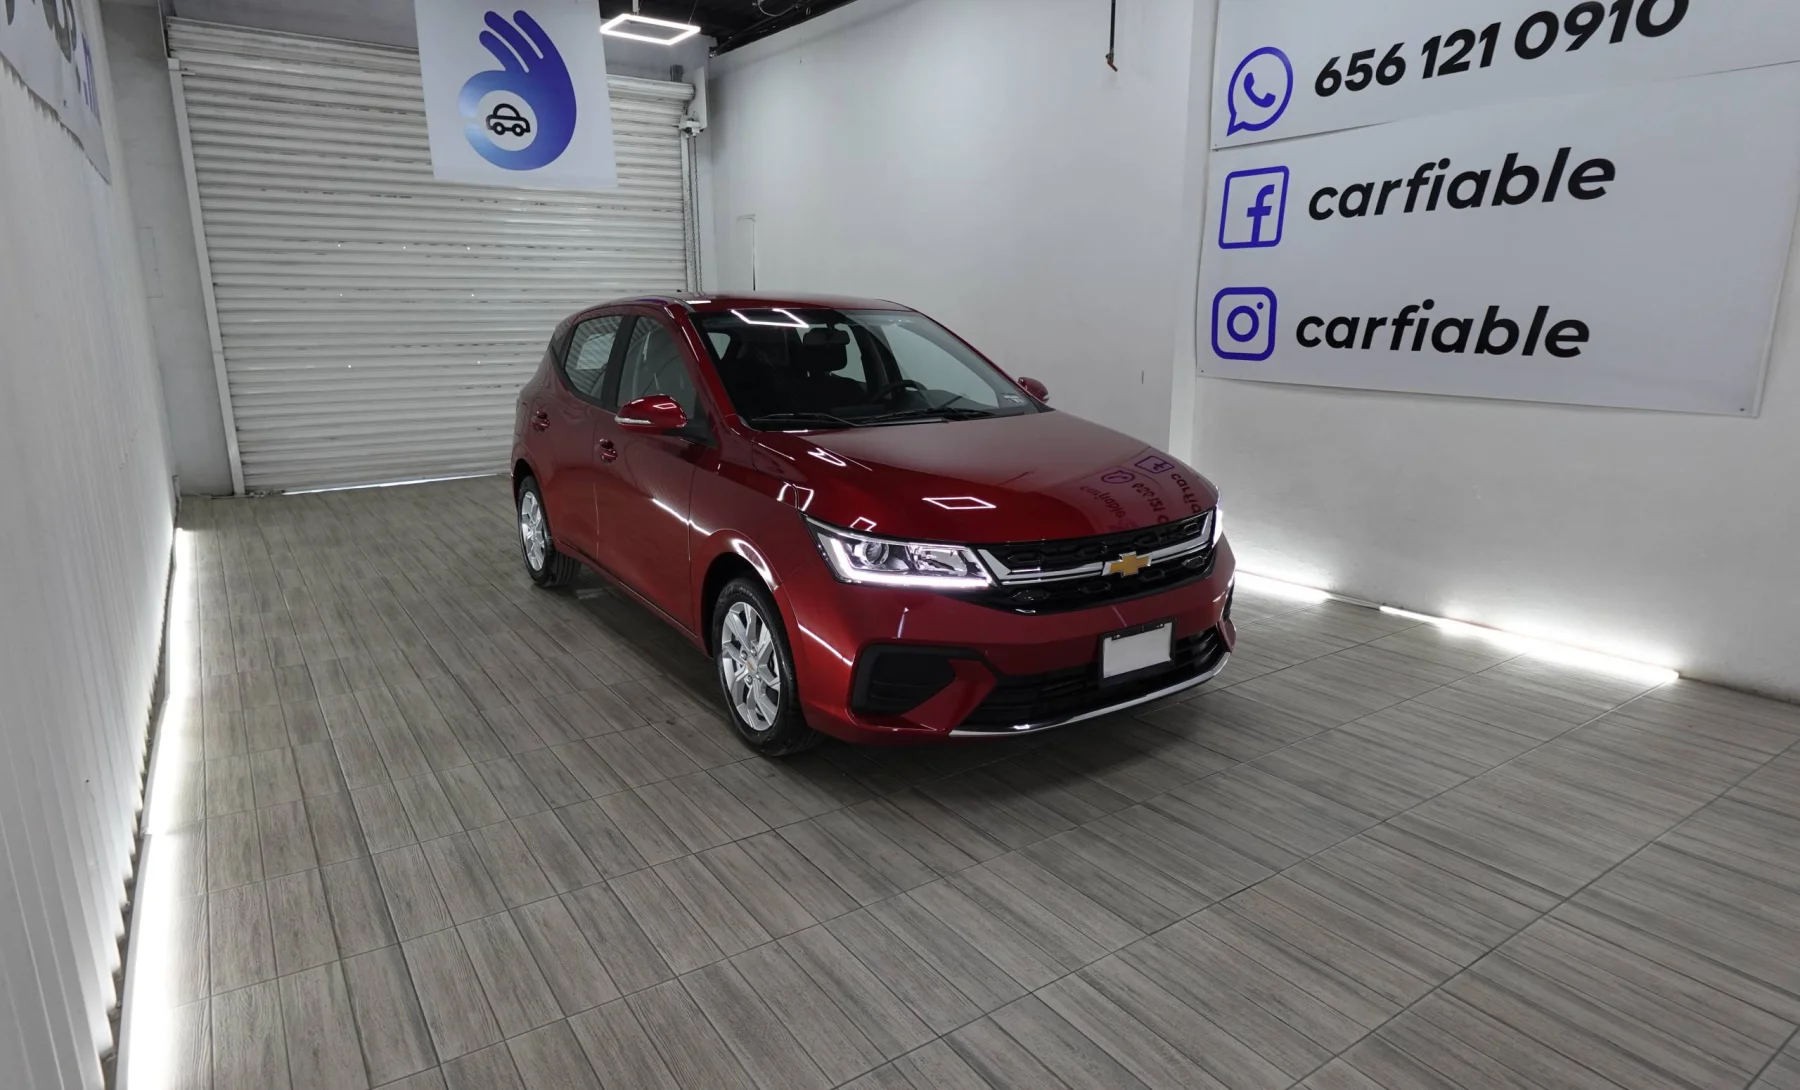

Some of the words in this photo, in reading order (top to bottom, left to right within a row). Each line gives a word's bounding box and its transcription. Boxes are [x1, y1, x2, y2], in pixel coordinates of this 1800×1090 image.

[1315, 42, 1406, 97] 656
[1421, 22, 1501, 79] 121
[1514, 0, 1690, 60] 0910
[1308, 147, 1616, 221] carfiable
[1296, 299, 1590, 359] carfiable
